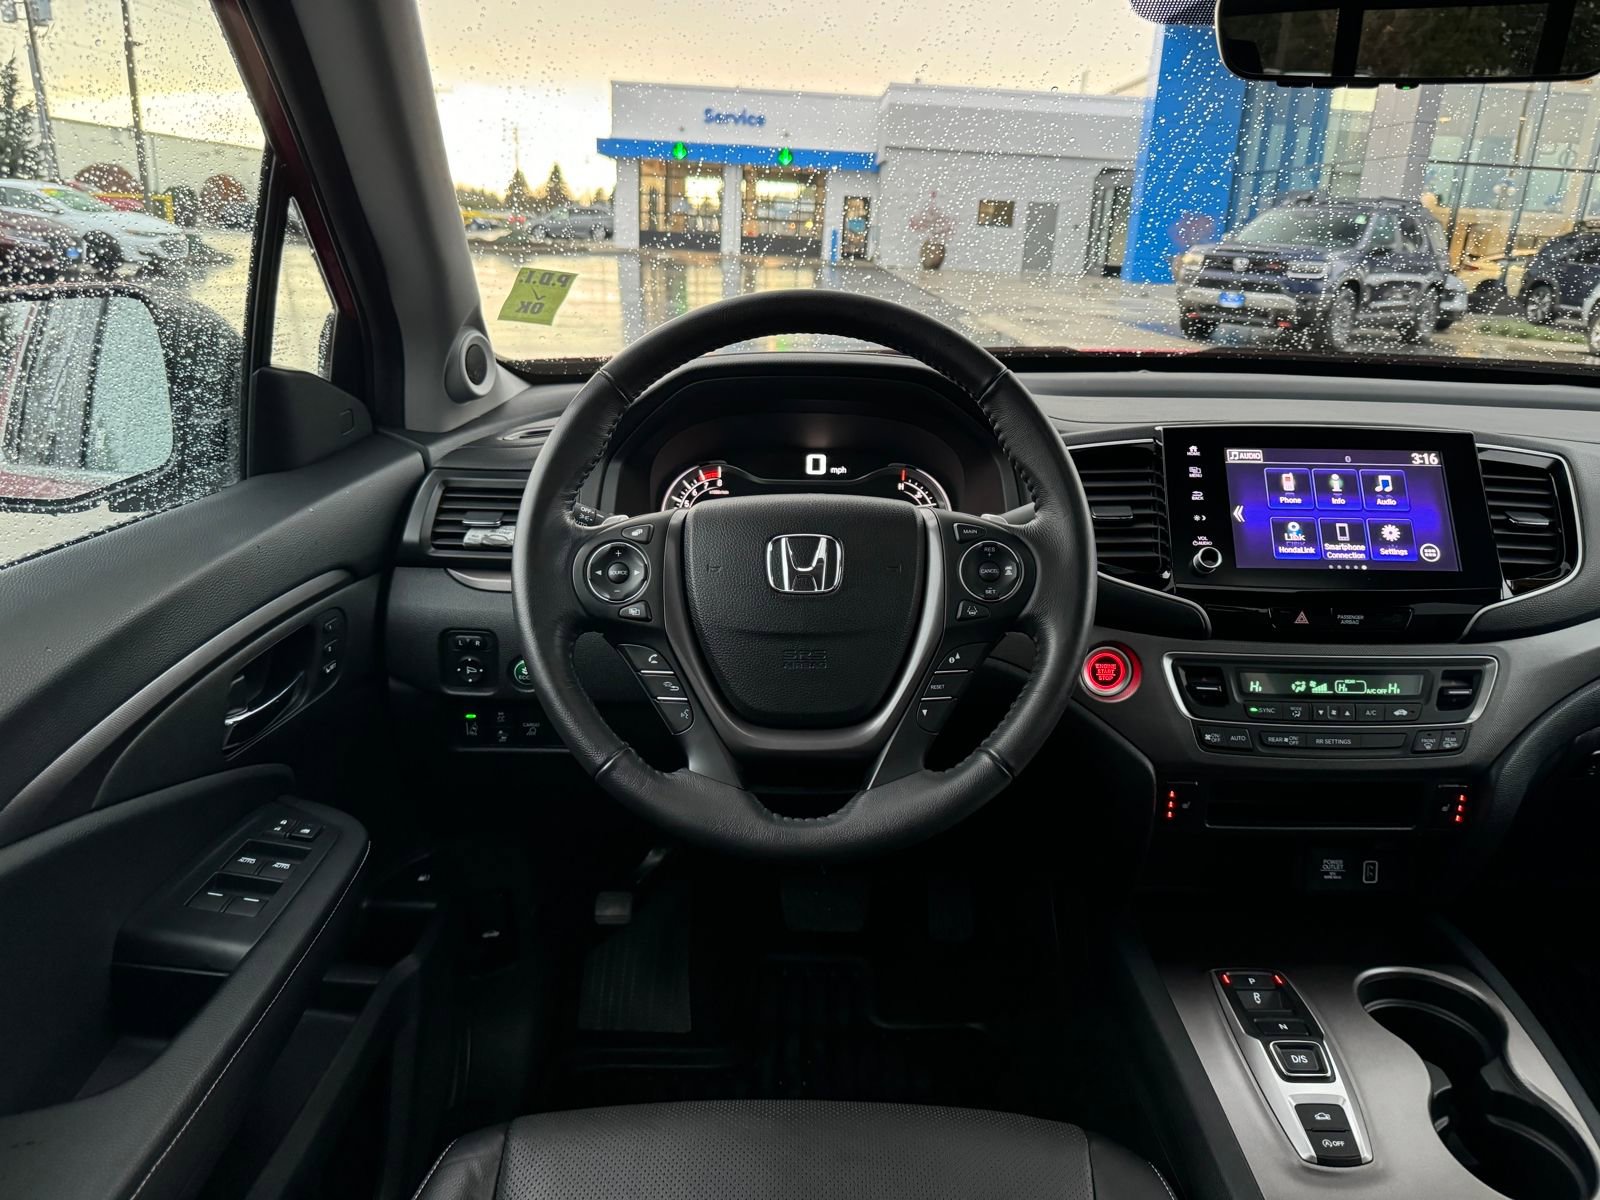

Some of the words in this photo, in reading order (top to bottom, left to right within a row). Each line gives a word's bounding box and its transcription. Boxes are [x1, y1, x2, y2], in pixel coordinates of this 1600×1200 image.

[704, 108, 766, 126] Service
[1239, 452, 1261, 460] AUDIO
[1411, 452, 1439, 465] 3:16
[806, 454, 826, 475] 0
[830, 465, 847, 475] mph
[1279, 496, 1302, 504] Phone
[1331, 497, 1346, 505] Info
[1376, 498, 1397, 506] Audio
[1278, 545, 1315, 554] HondaLink
[1324, 543, 1366, 552] Smartphone
[1326, 551, 1366, 560] Connection
[1379, 548, 1408, 557] Settings
[1290, 1055, 1309, 1064] D/S
